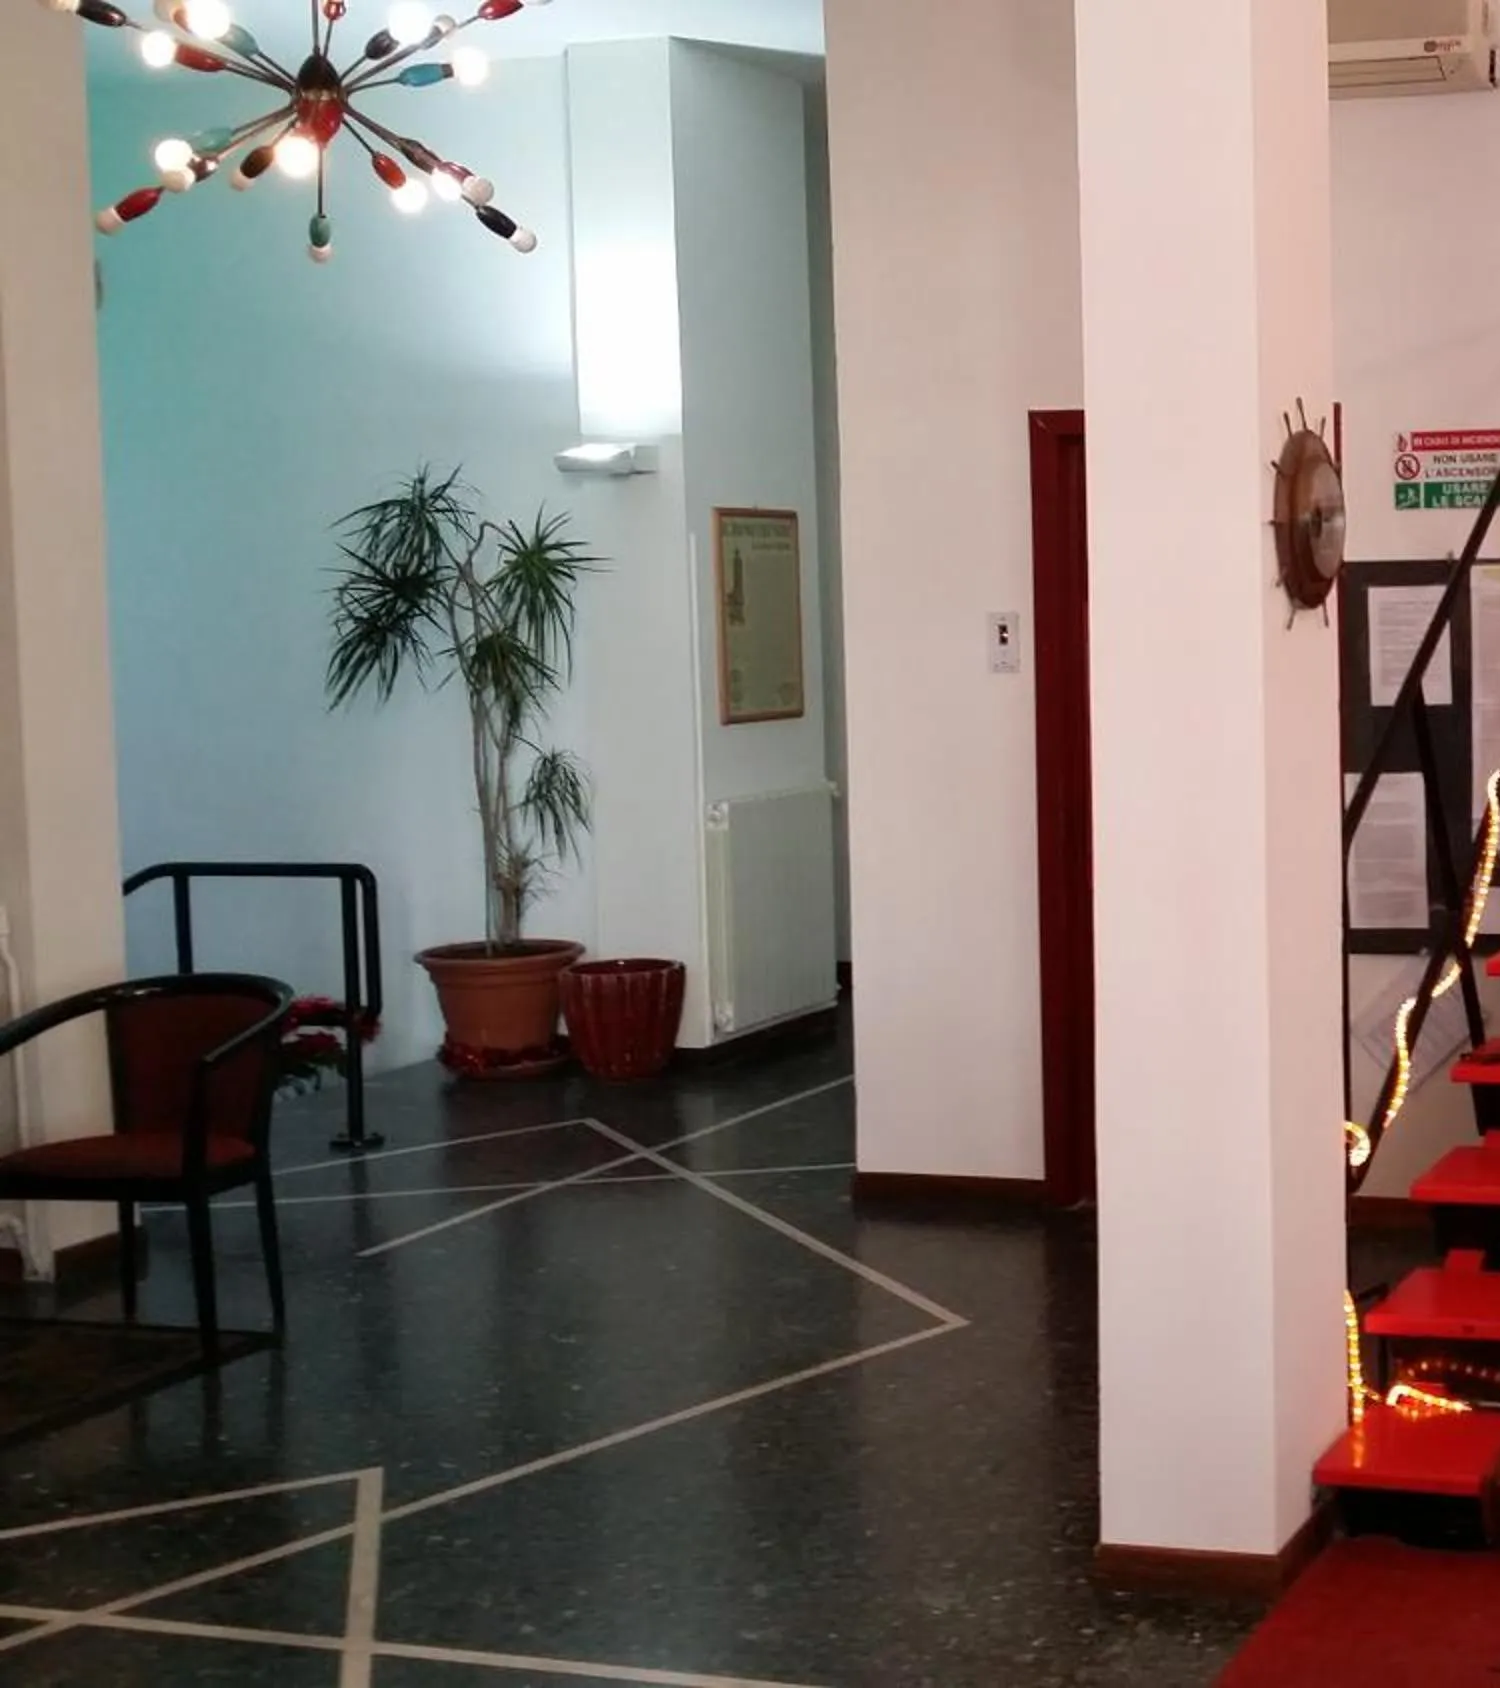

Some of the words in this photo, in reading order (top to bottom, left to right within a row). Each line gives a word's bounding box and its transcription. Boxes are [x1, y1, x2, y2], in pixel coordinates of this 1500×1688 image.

[1433, 455, 1457, 464] NON
[1461, 453, 1497, 463] USARE
[1442, 482, 1488, 495] USARE
[1432, 495, 1447, 507] LE
